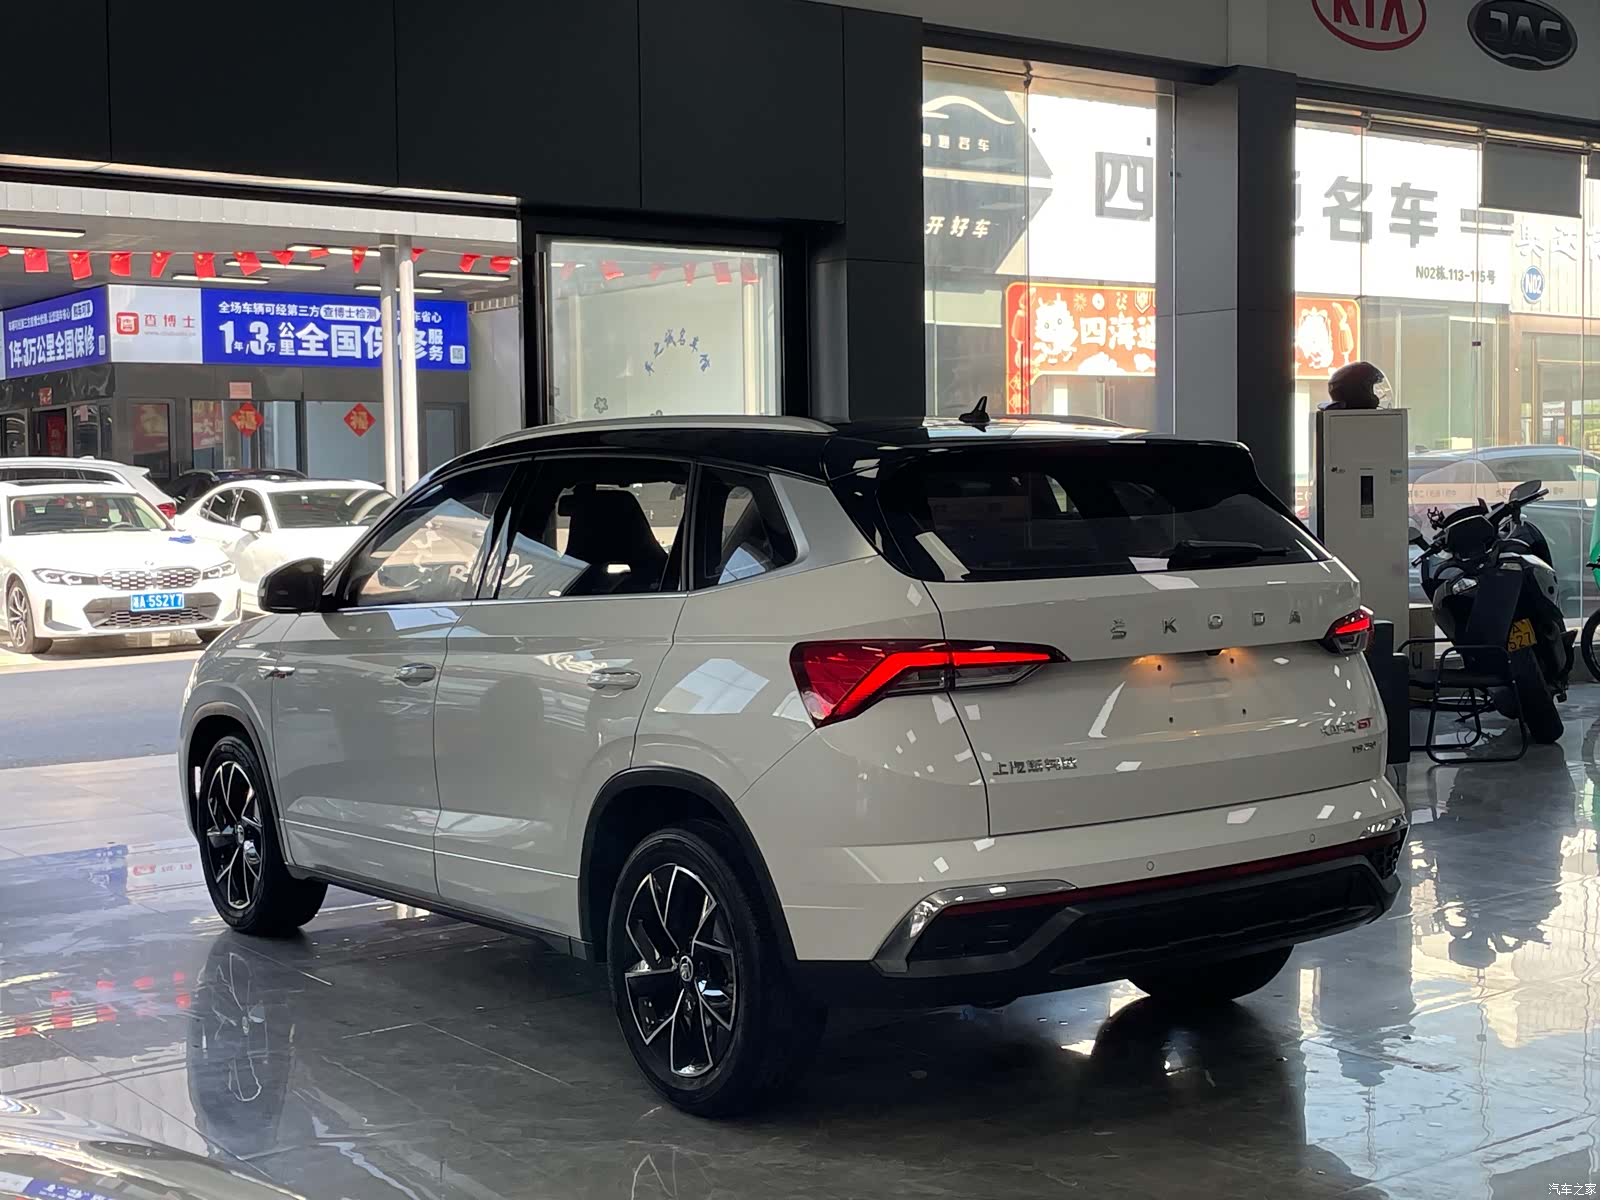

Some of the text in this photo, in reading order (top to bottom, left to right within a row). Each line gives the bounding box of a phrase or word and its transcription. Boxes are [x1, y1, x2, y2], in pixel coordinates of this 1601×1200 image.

[1333, 0, 1409, 35] KIA
[1488, 9, 1562, 49] JAC
[1094, 151, 1154, 222] 四
[144, 314, 196, 329] 查博士
[1110, 609, 1302, 640] ŠKODA
